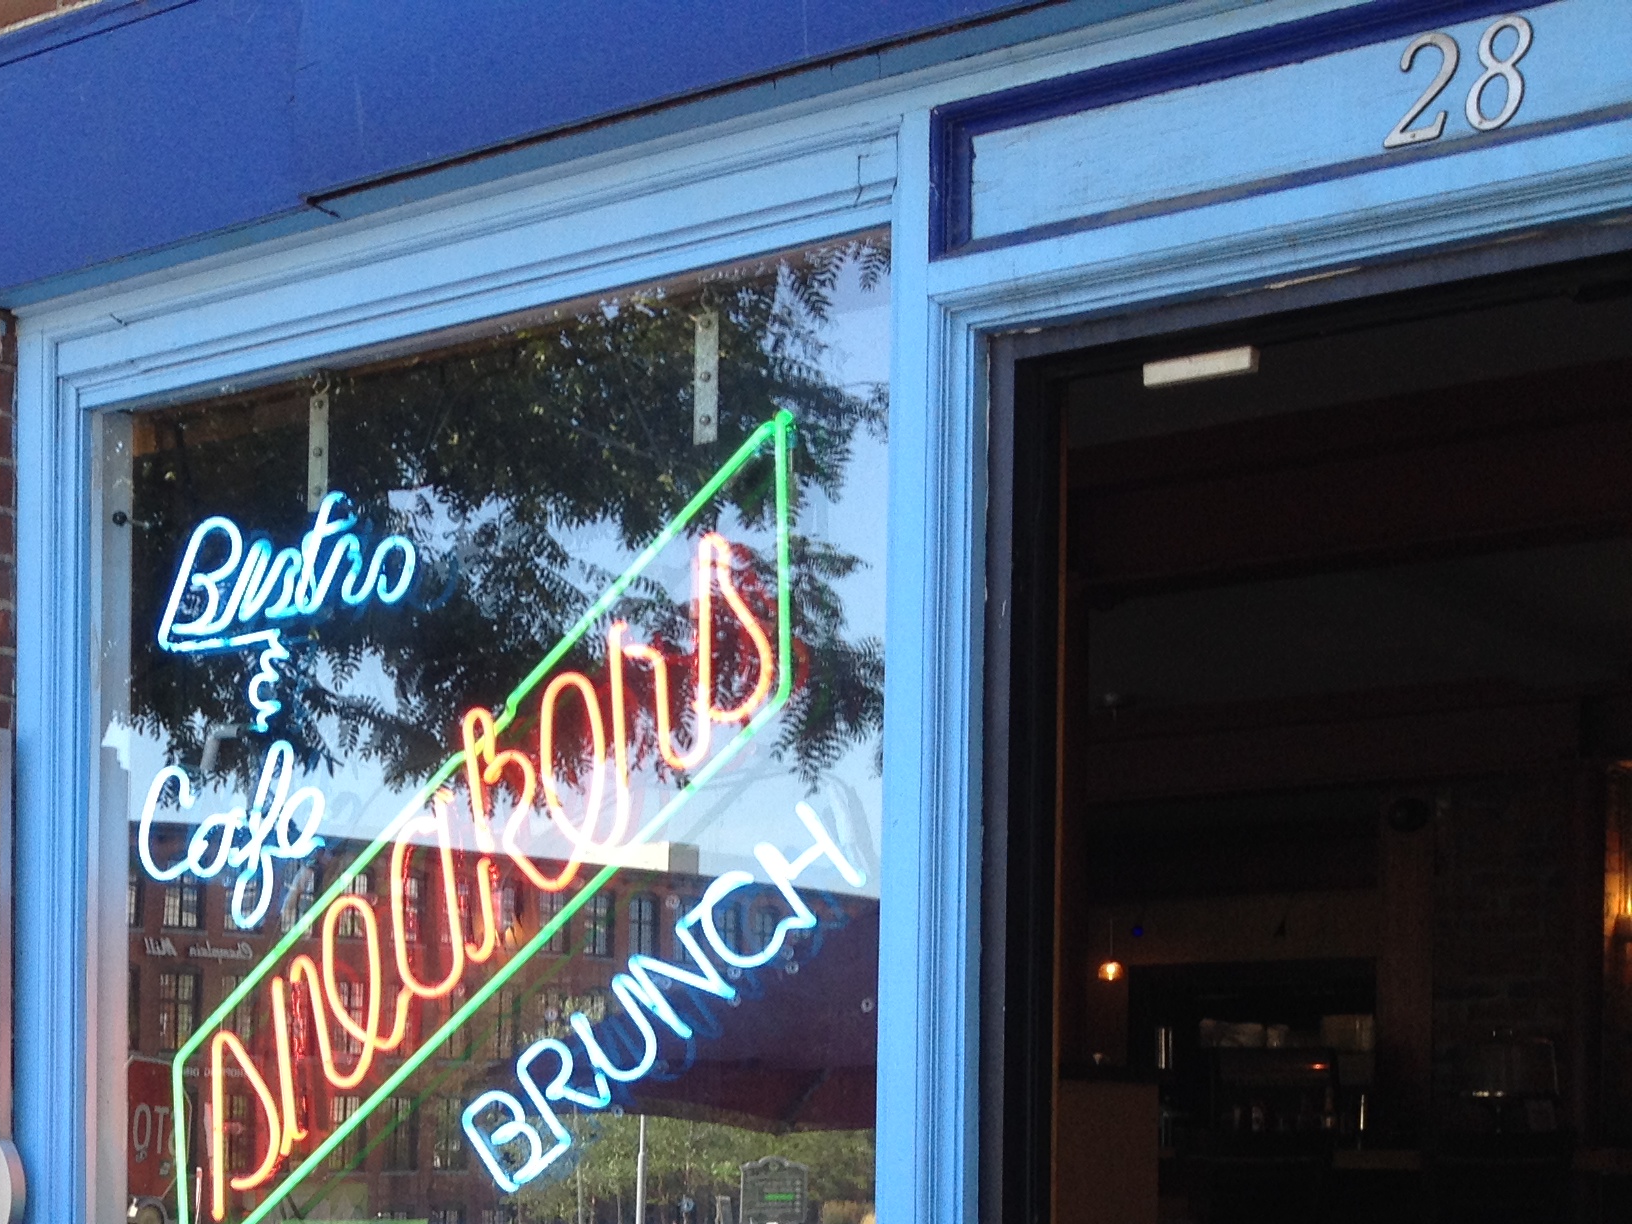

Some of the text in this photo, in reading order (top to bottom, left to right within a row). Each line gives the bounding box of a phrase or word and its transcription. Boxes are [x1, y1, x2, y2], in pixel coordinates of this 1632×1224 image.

[1382, 14, 1534, 149] 28
[157, 490, 417, 650] Bistro
[137, 739, 326, 930] Cafe
[210, 531, 774, 1223] Sneakers
[461, 800, 867, 1193] BRUNCH
